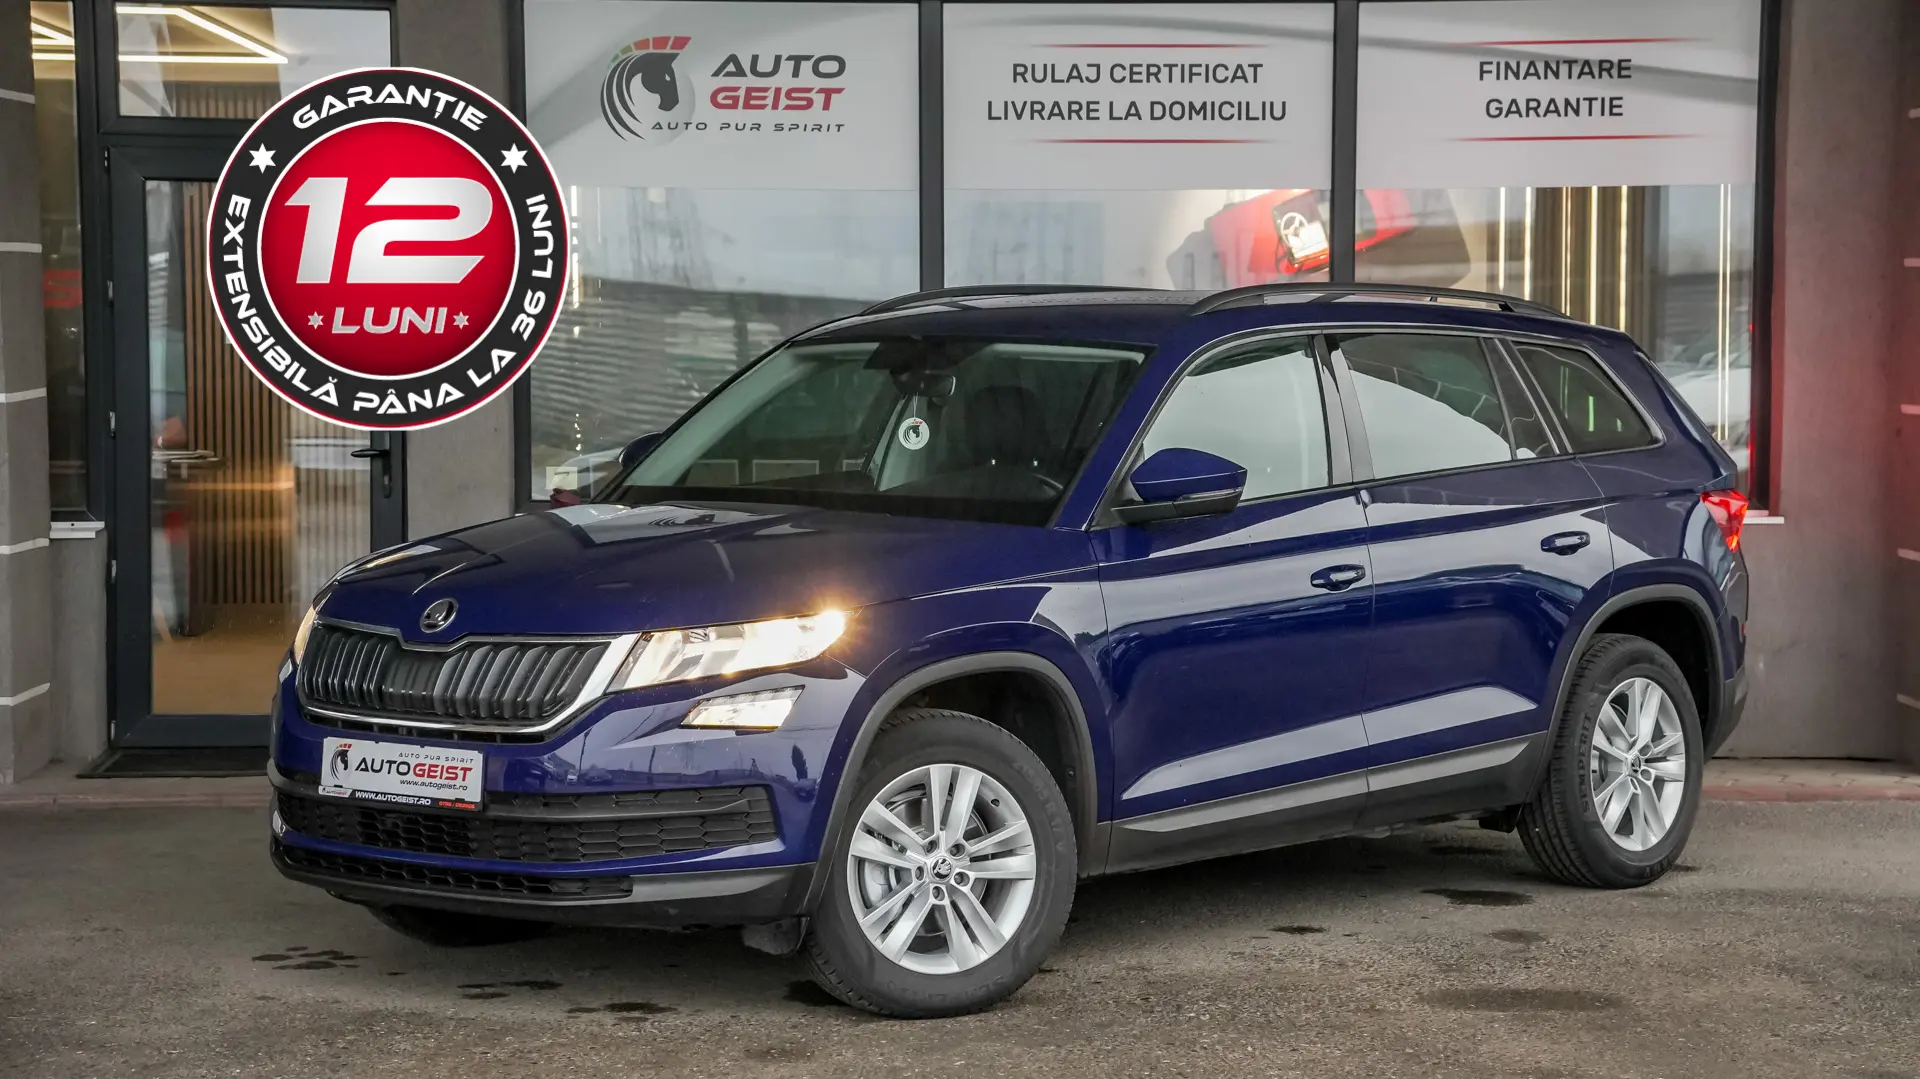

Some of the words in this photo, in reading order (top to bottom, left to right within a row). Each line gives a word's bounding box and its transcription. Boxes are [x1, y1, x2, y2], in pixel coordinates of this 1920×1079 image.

[709, 53, 847, 79] AUTO
[1012, 63, 1101, 84] RULAJ
[1109, 63, 1263, 84] CERTIFICAT
[1479, 58, 1632, 81] FINANTARE
[709, 86, 846, 111] GEIST
[1485, 96, 1624, 118] GARANTIE
[987, 100, 1101, 121] LIVRARE
[1108, 100, 1143, 121] LA
[1150, 100, 1287, 121] DOMICILIU
[651, 121, 708, 131] AUTO
[719, 122, 762, 132] PUR
[773, 122, 845, 133] SPIRIT
[445, 756, 474, 764] SPIRIT
[399, 779, 468, 791] www.autogeist.ro
[355, 791, 431, 806] WWW.AUTOGEIST.RO
